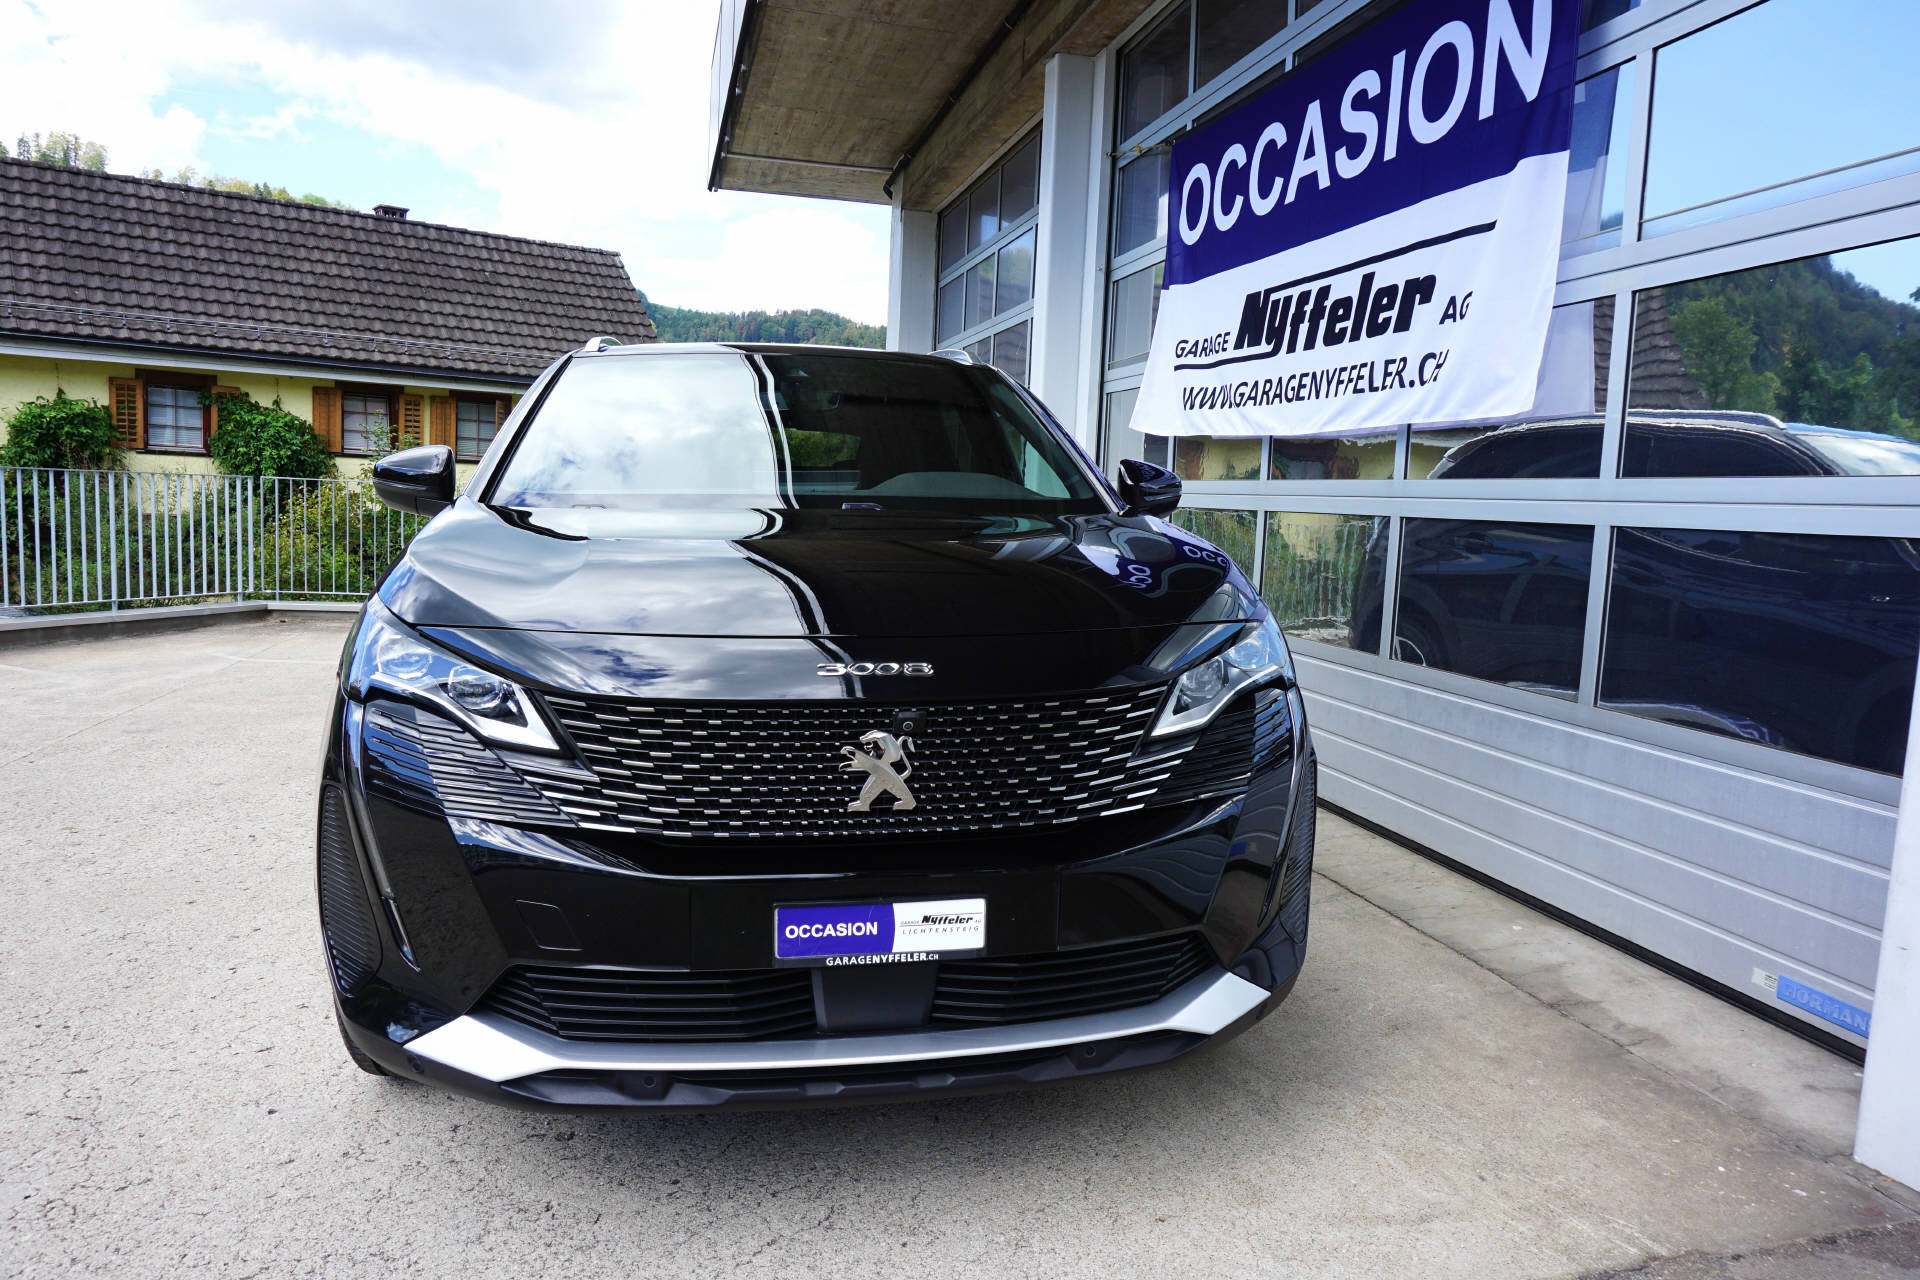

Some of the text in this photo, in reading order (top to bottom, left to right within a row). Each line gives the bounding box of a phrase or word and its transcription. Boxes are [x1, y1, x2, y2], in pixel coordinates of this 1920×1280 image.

[1179, 0, 1552, 245] OCCASION
[1176, 271, 1473, 358] GARAGE Nyffeler AG
[816, 662, 934, 676] 3008
[921, 915, 973, 925] Nyffeler
[785, 921, 878, 939] OCCASION
[902, 926, 979, 935] LICHTENSTEIG
[825, 952, 939, 966] GARAGENYFFELER.CH
